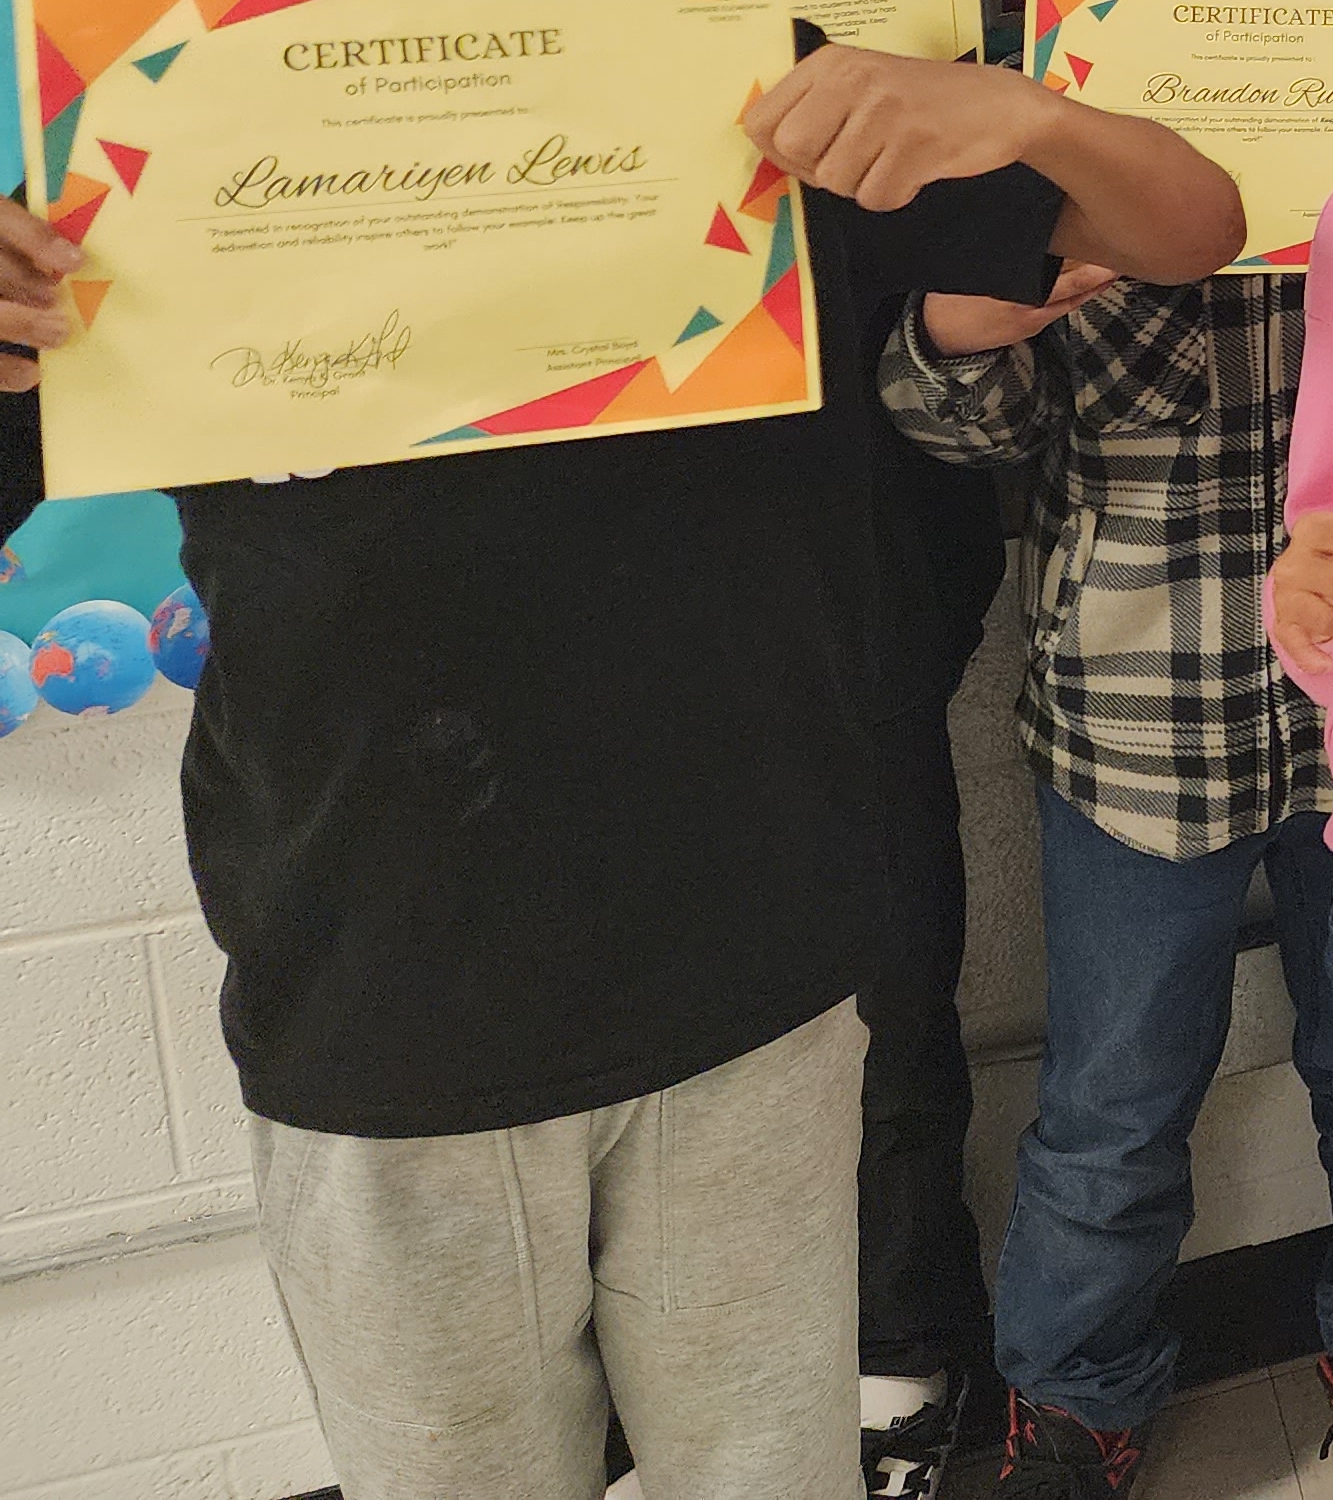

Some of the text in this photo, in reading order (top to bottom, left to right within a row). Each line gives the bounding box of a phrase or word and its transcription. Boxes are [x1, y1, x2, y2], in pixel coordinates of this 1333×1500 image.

[284, 28, 564, 72] CERTIFICATE
[1206, 30, 1304, 45] of Participation
[345, 73, 511, 96] of Participation
[1140, 73, 1280, 105] Brandon
[215, 134, 647, 208] Lamariyen Lewis
